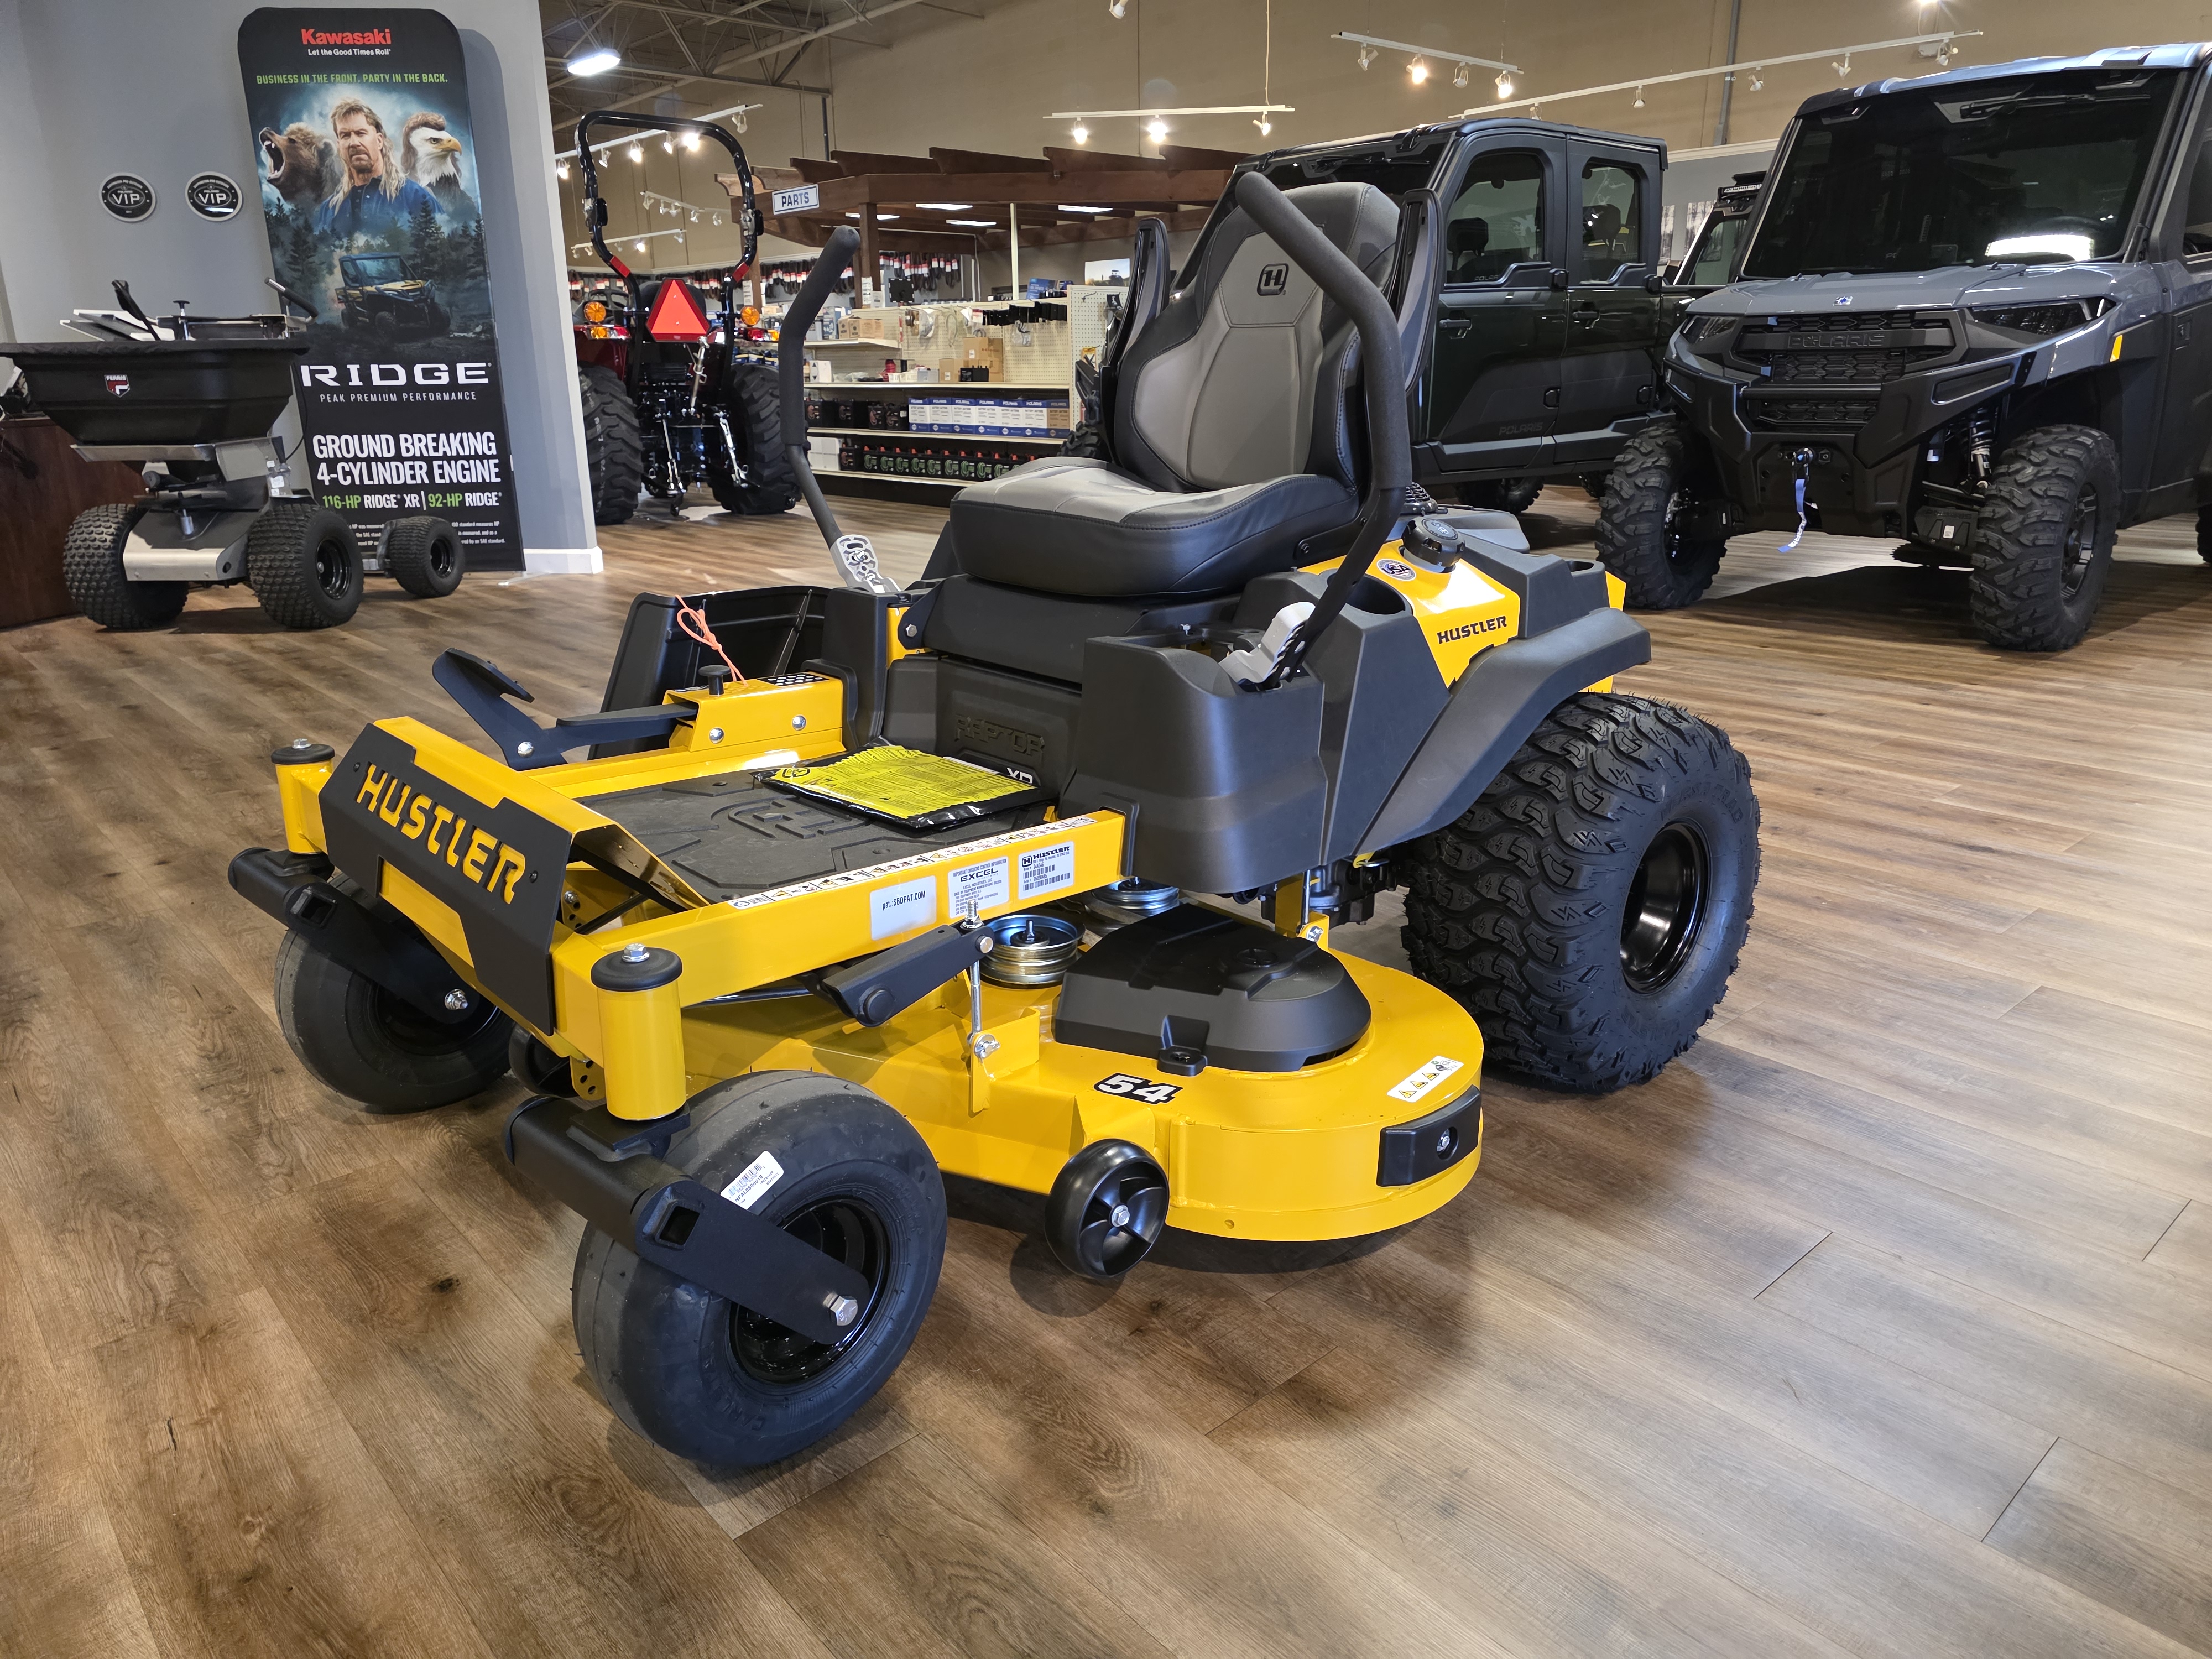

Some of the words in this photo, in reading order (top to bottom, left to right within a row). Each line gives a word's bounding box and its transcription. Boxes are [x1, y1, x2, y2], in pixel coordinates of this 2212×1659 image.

[301, 29, 392, 44] Kawasaki
[257, 75, 299, 84] BUSINESS
[301, 74, 310, 83] IN
[312, 74, 328, 83] THE
[330, 74, 360, 83] FRONT.
[363, 74, 390, 82] PARTY
[392, 74, 401, 82] IN
[403, 74, 420, 82] THE
[422, 73, 448, 82] BACK.
[112, 194, 140, 204] VIP
[199, 193, 226, 204] VIP
[781, 192, 809, 207] PARTS
[1787, 333, 1885, 348] POLARIS
[300, 362, 489, 387] RIDGE
[320, 393, 345, 403] PEAK
[350, 393, 397, 402] PREMIUM
[403, 391, 476, 401] PERFORMANCE
[1499, 422, 1543, 436] POLARIS
[313, 434, 395, 458] GROUND
[399, 432, 497, 457] BREAKING
[317, 461, 430, 486] 4-CYLINDER
[432, 459, 501, 484] ENGINE
[322, 495, 361, 509] 116-HP
[403, 494, 420, 508] XR
[428, 493, 463, 507] 92-HP
[1381, 564, 1412, 574] USA
[1437, 616, 1507, 644] HUSTLER
[954, 713, 1045, 757] RAPTOR
[356, 764, 527, 904] HUSTLER
[1033, 846, 1070, 859] HUSTLER
[961, 868, 998, 882] EXCEL
[882, 890, 926, 911] pat.:SBDPAT.COM
[1098, 1074, 1176, 1102] 54
